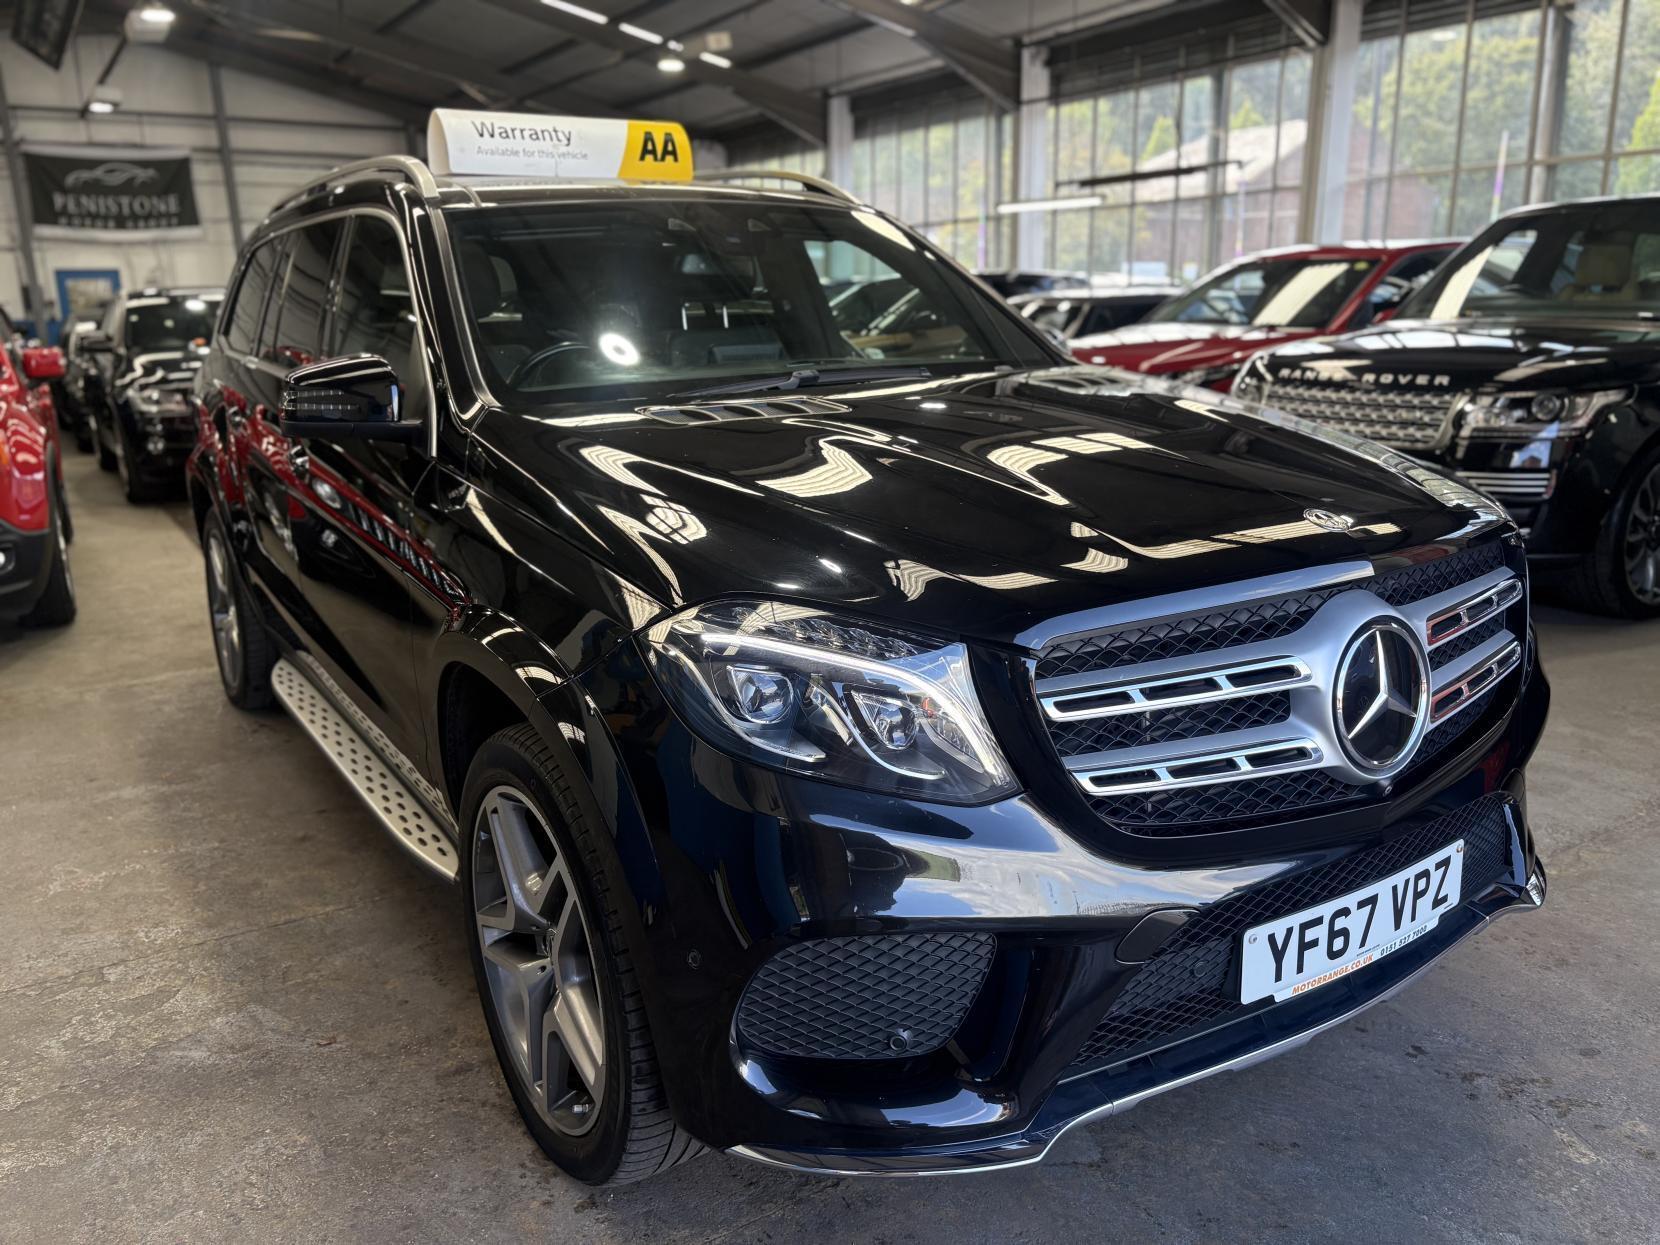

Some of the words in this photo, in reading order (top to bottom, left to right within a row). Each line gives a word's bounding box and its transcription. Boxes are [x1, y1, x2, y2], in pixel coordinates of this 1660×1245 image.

[471, 120, 572, 147] Warranty
[638, 131, 679, 162] AA
[476, 146, 520, 157] Available
[522, 148, 536, 158] for
[537, 149, 554, 159] this
[556, 151, 588, 161] vehicle
[53, 191, 180, 216] PENISTONE
[1278, 367, 1346, 382] RANGE
[1361, 372, 1451, 387] ROVER
[1267, 892, 1379, 984] YF67
[1391, 855, 1452, 932] VPZ
[1292, 953, 1374, 995] MOTORRANGE.CO.UK
